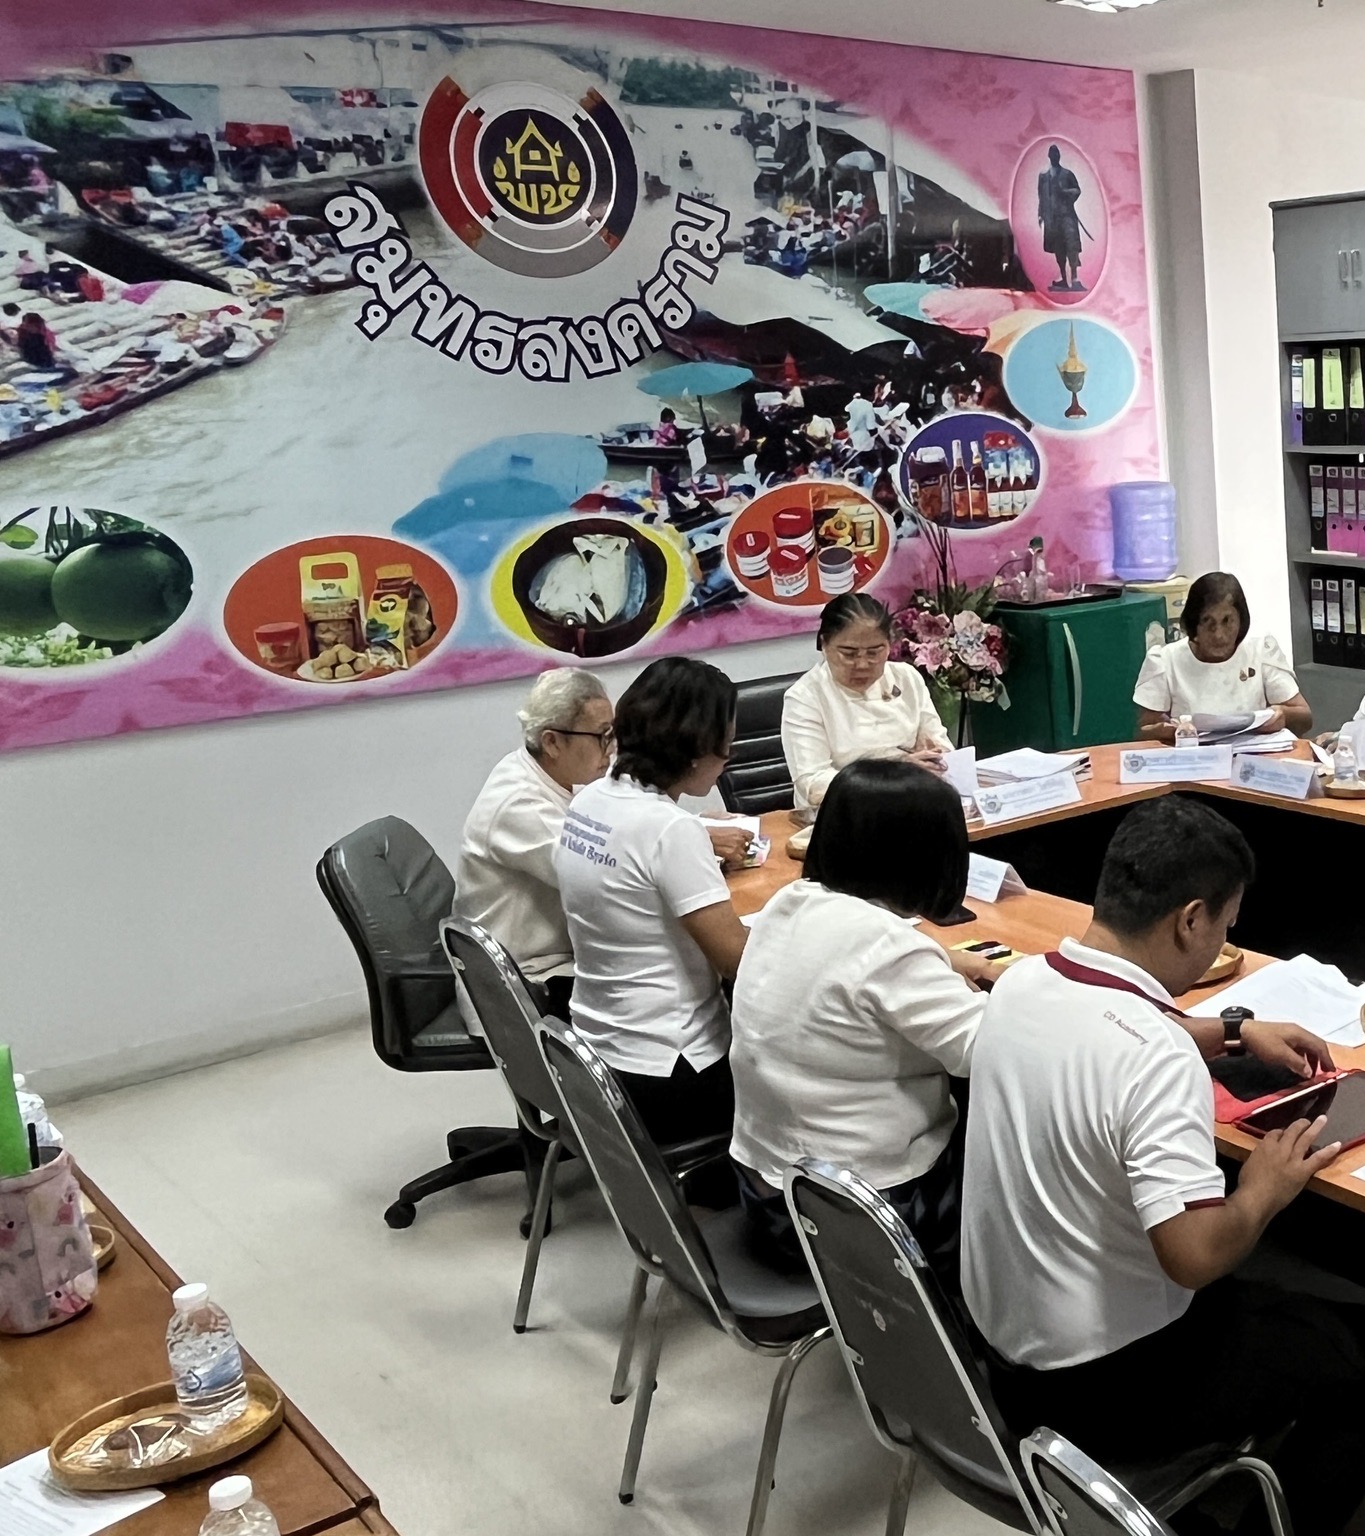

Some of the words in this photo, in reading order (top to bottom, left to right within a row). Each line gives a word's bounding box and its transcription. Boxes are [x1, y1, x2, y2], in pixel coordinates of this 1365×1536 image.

[321, 181, 730, 382] สมุทรสงคราม
[1103, 1010, 1116, 1021] CD
[1115, 1019, 1149, 1046] Academy
